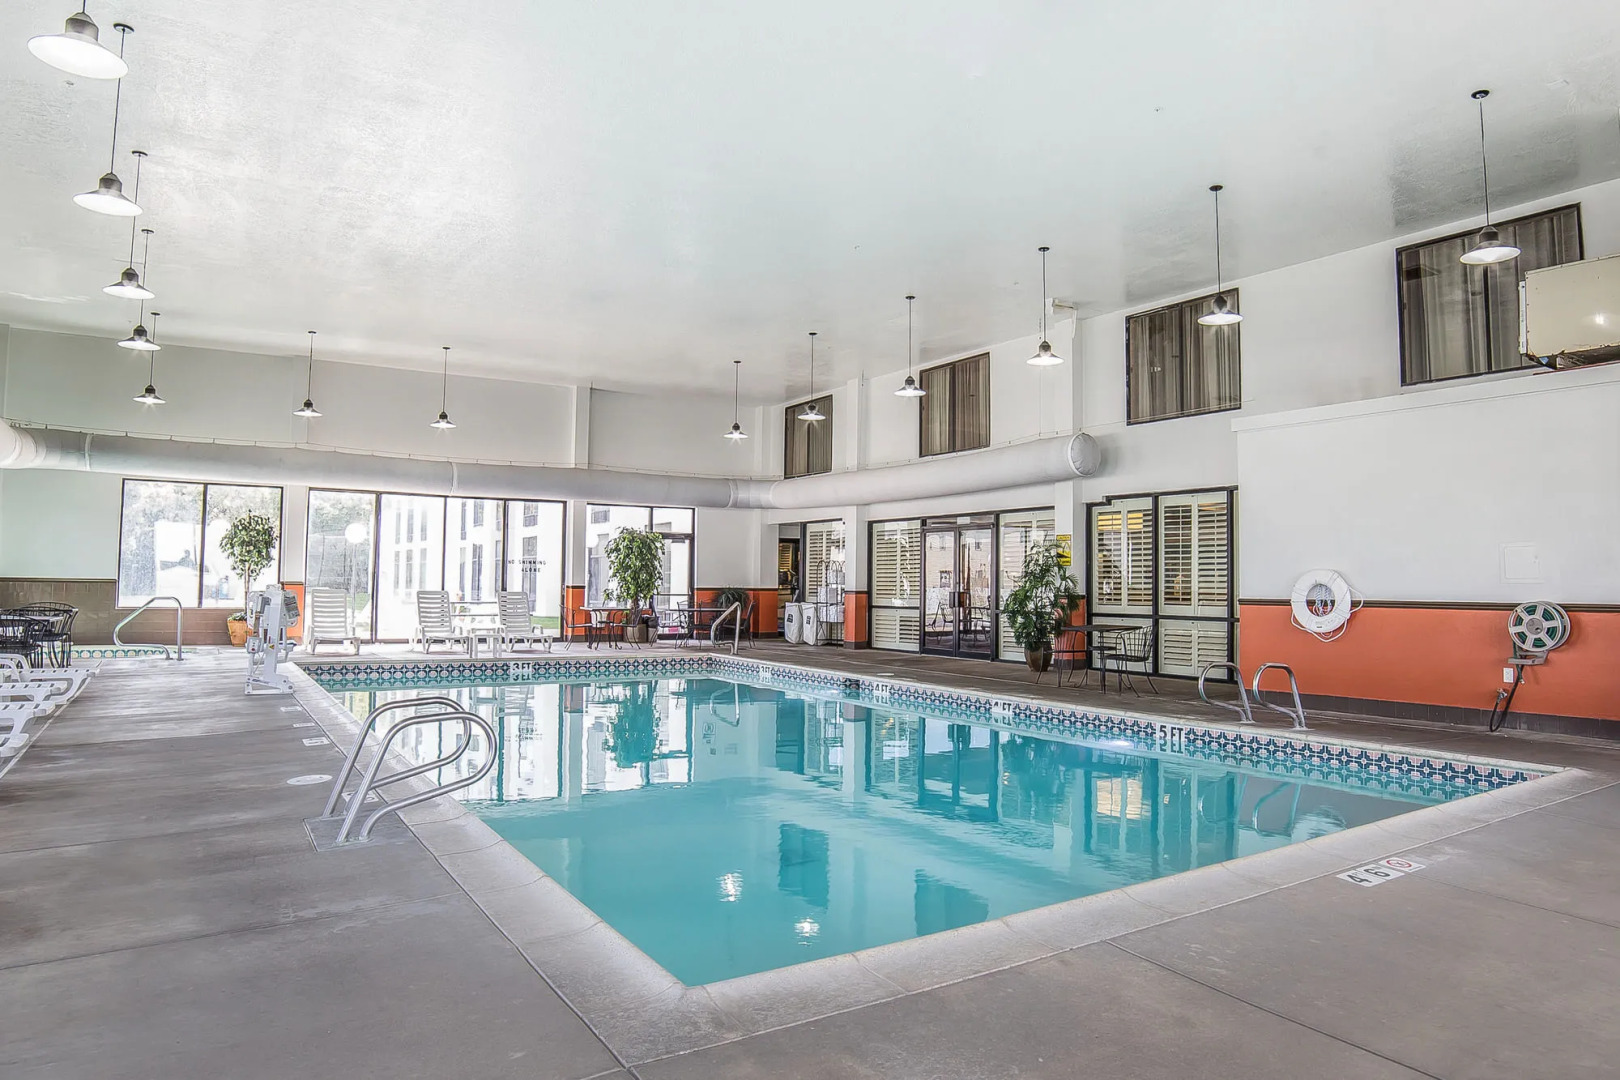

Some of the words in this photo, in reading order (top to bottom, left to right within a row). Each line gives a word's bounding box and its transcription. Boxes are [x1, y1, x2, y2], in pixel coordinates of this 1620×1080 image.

[512, 662, 520, 670] 3
[881, 684, 888, 693] FT
[1159, 724, 1167, 739] 5
[1171, 726, 1183, 740] FT
[1346, 874, 1372, 883] 4
[1363, 868, 1391, 877] 6
